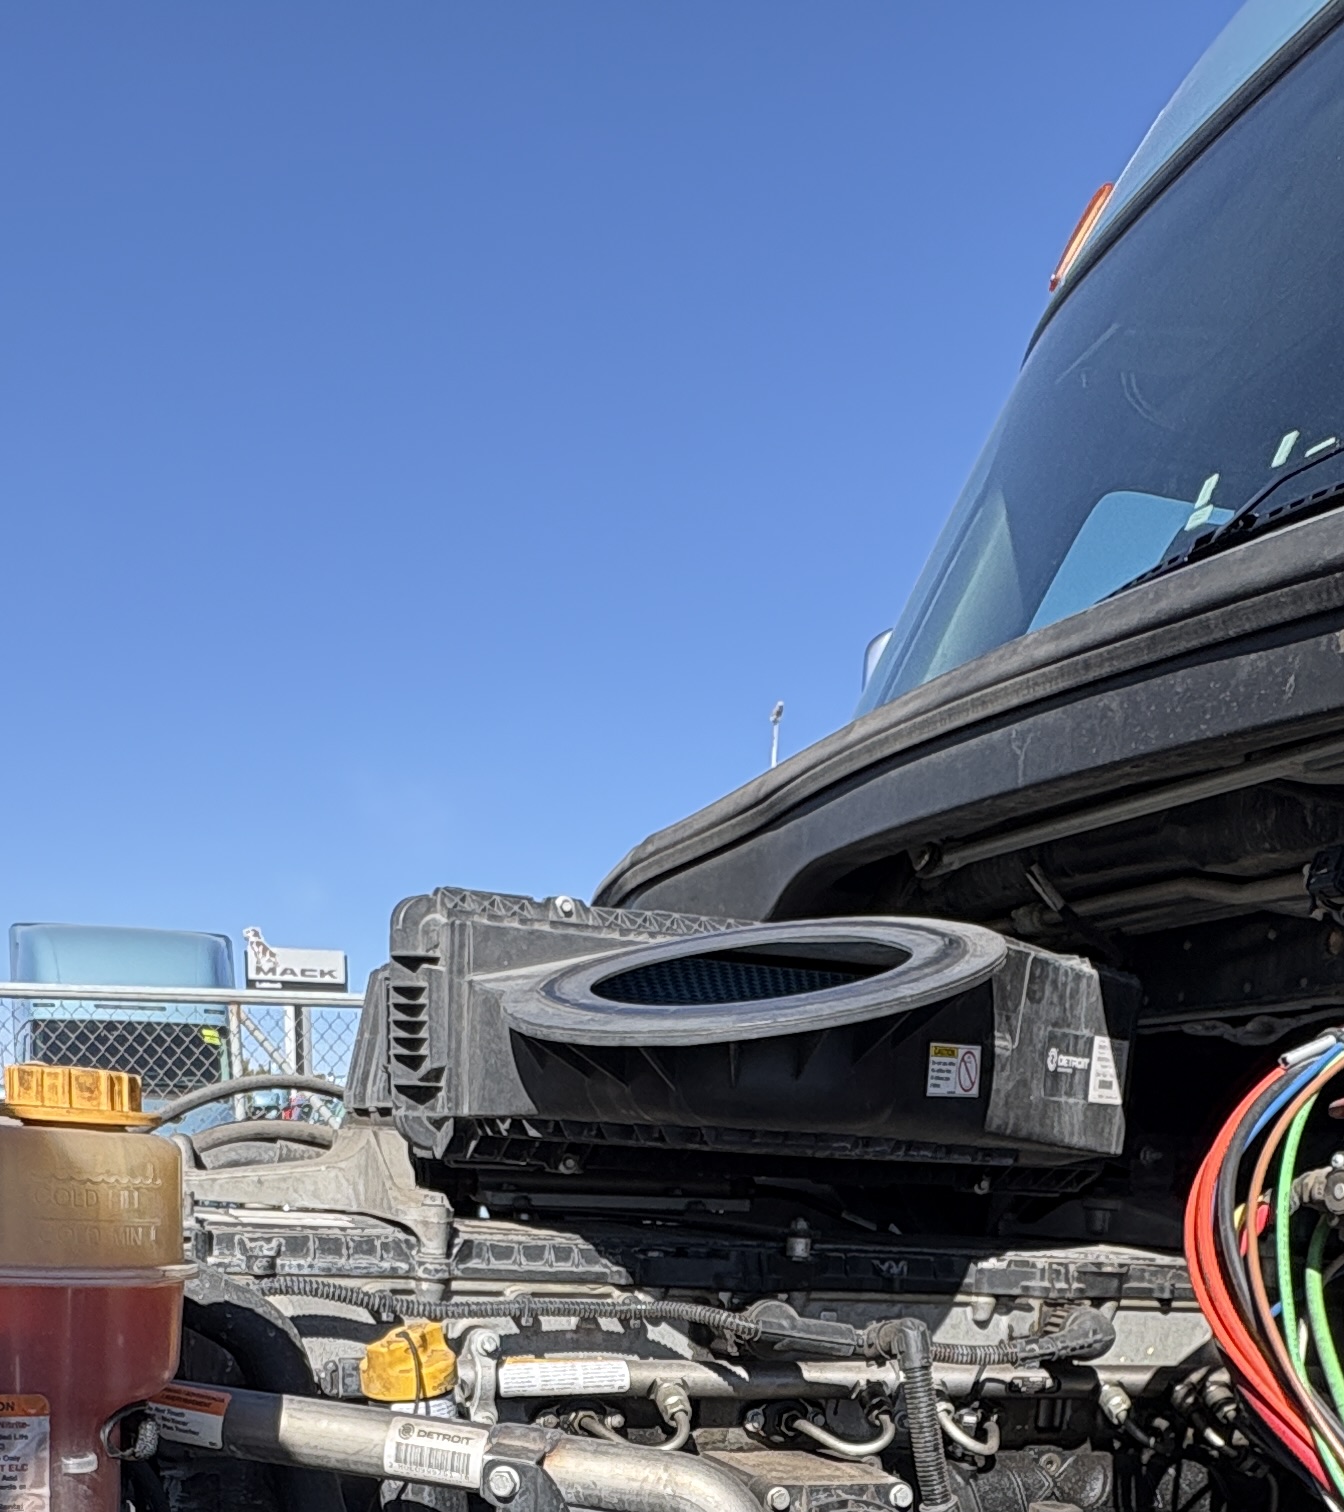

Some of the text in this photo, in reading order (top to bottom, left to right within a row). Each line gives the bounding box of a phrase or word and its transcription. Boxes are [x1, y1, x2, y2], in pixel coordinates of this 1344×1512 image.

[255, 966, 337, 979] MACK
[1058, 1055, 1090, 1069] DETROIT
[417, 1430, 474, 1445] DETROIT
[8, 1464, 28, 1472] ELC
